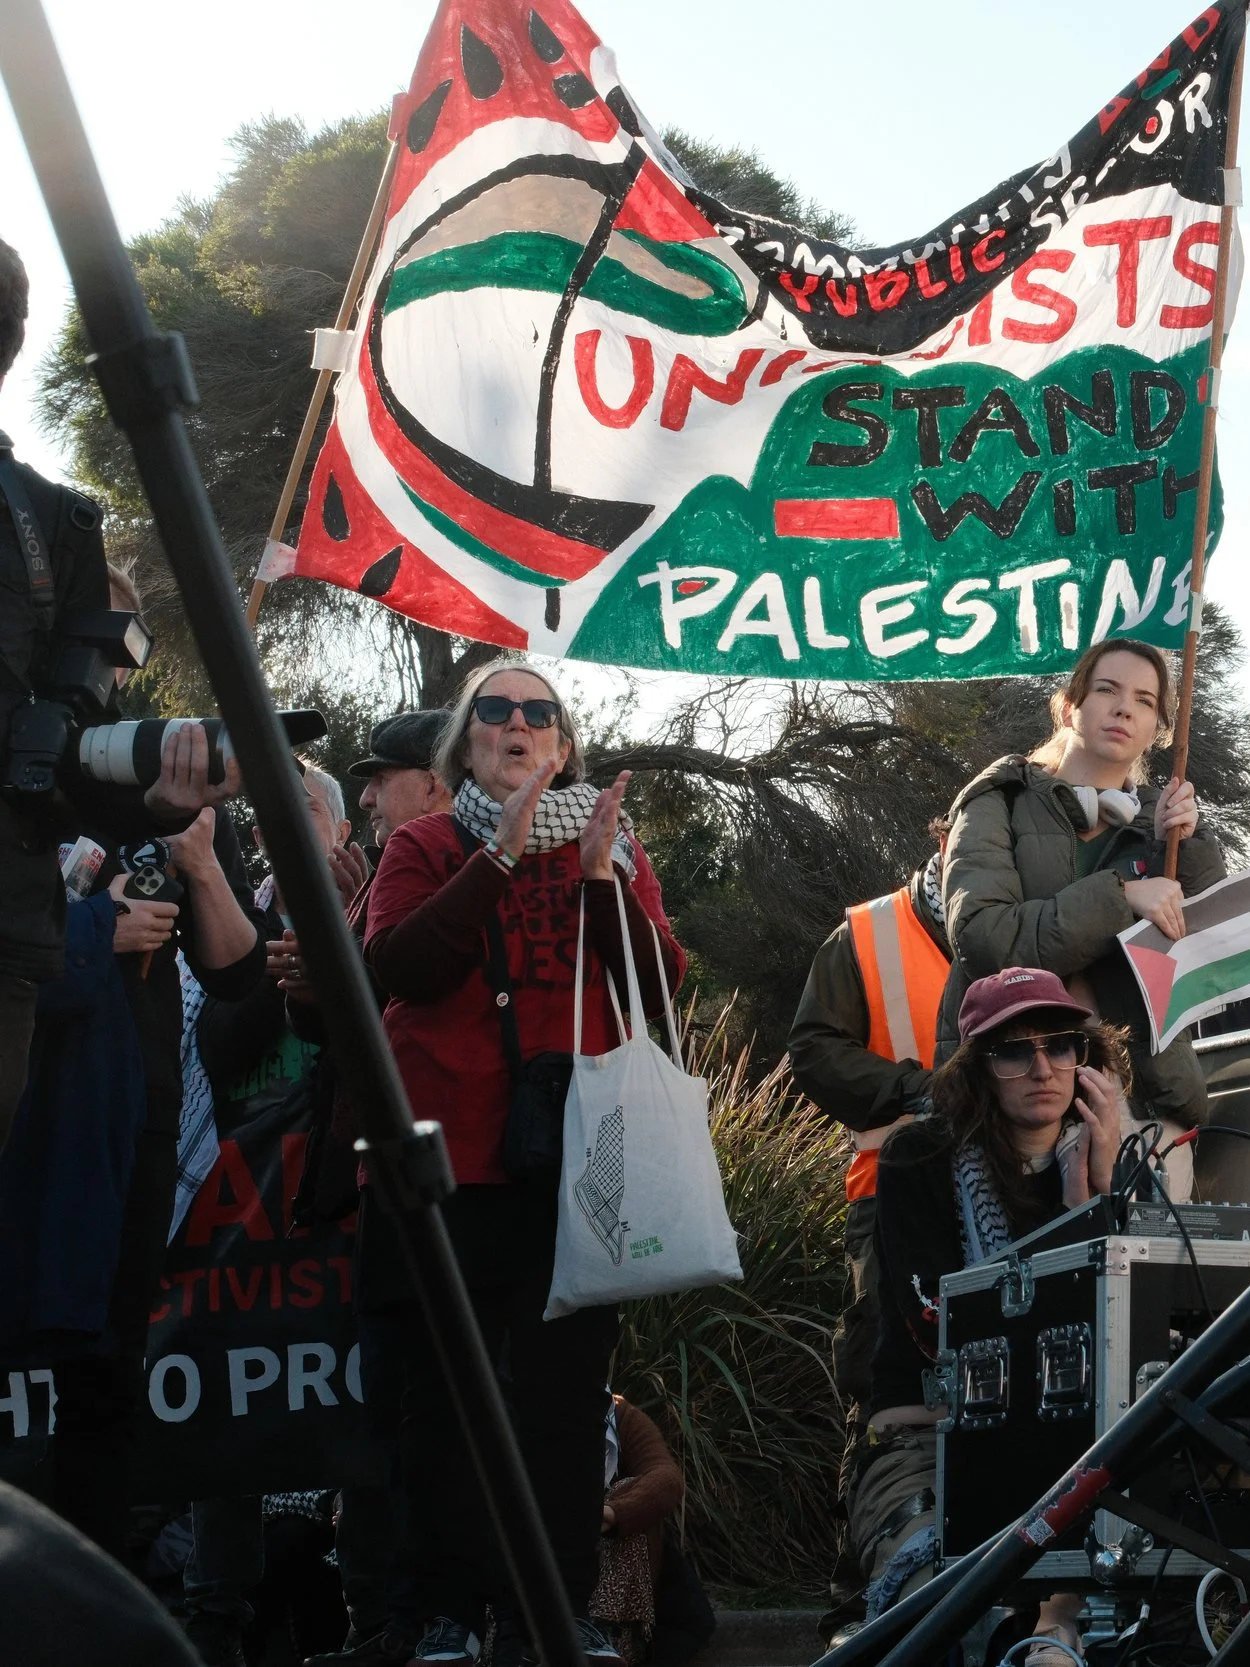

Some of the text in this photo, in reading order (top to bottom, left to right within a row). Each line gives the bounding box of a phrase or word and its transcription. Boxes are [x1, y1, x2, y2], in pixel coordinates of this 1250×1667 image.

[806, 369, 1186, 468] STAND
[14, 506, 45, 571] SONY
[637, 557, 1206, 662] PALESTINE
[1004, 974, 1035, 986] HABIBI
[147, 1353, 202, 1423] O
